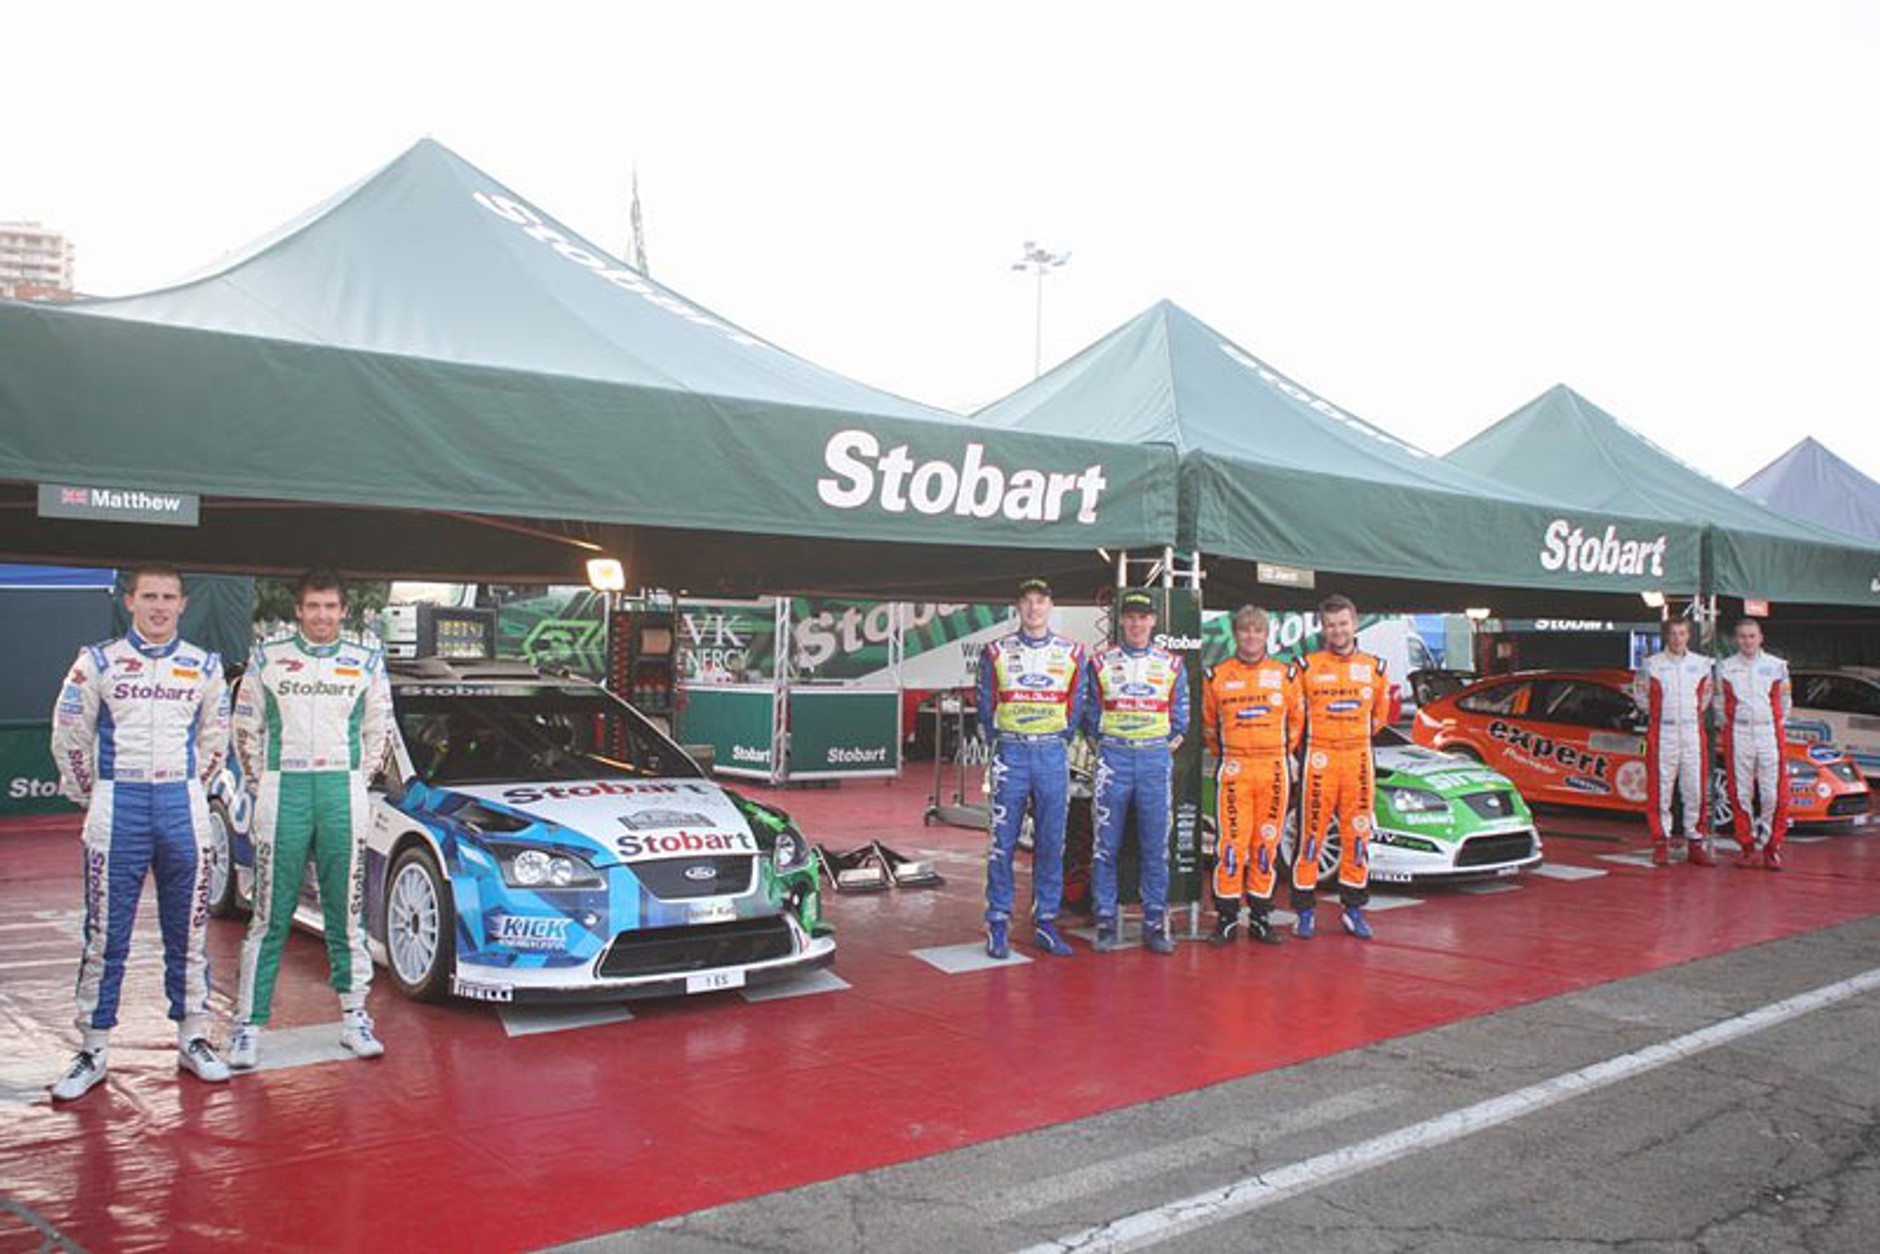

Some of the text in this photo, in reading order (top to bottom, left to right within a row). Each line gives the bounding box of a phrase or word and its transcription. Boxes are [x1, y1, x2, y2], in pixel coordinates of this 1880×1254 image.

[817, 429, 1106, 524] Stobart
[91, 489, 181, 512] Matthew
[1539, 518, 1668, 577] Stobart
[682, 614, 746, 646] VK
[114, 683, 196, 701] Stobart
[277, 680, 357, 697] Stobart
[826, 746, 886, 763] Stobart
[1489, 720, 1608, 777] expert
[9, 777, 60, 798] Sto
[502, 782, 708, 804] Stobart
[616, 830, 752, 857] Stobart
[193, 846, 212, 928] Stobart
[351, 838, 366, 915] Stobart
[503, 918, 564, 938] KICK
